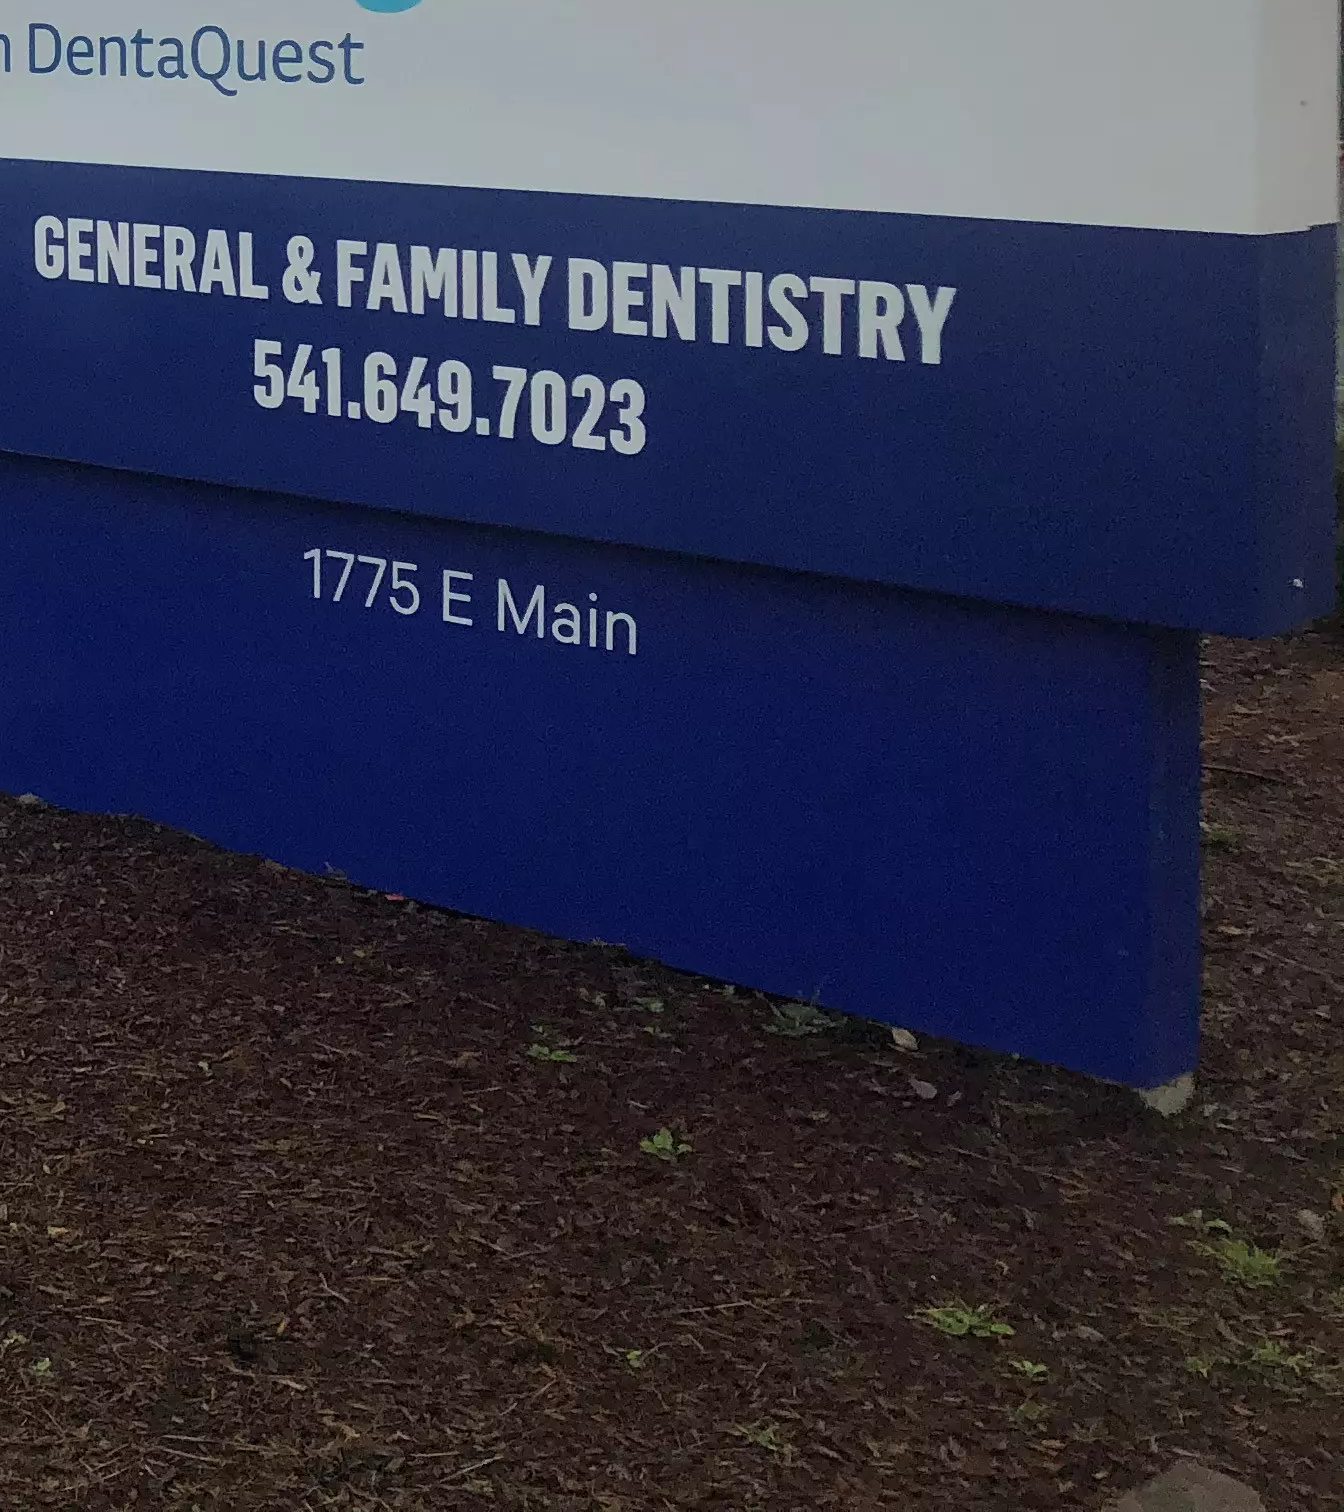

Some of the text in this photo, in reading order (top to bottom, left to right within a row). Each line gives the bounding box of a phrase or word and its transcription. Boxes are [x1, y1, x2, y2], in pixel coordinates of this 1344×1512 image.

[27, 22, 366, 98] DentaQuest
[35, 215, 957, 365] GENERAL & FAMILY DENTISTRY
[253, 338, 647, 455] 541.649.7023
[303, 548, 637, 655] 1775 E Main
